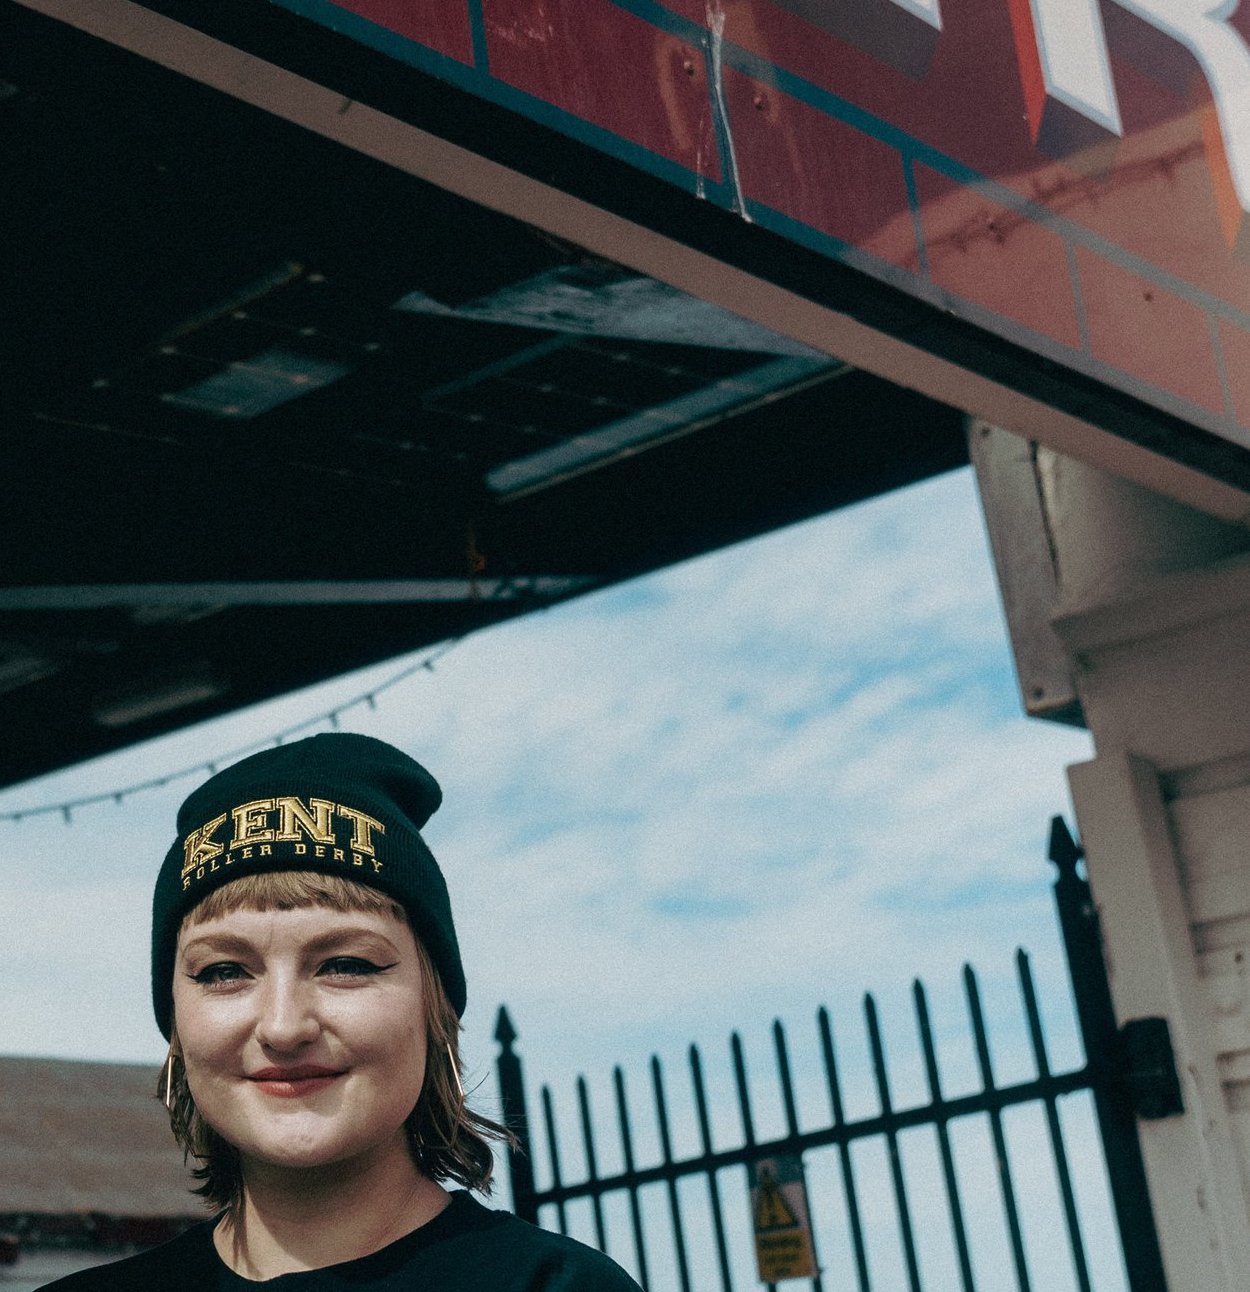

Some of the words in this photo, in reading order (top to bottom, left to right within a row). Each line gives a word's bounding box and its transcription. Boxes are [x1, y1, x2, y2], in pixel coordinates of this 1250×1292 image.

[180, 796, 386, 879] KENT
[181, 843, 273, 891] ROLLER
[294, 842, 384, 873] DERBY
